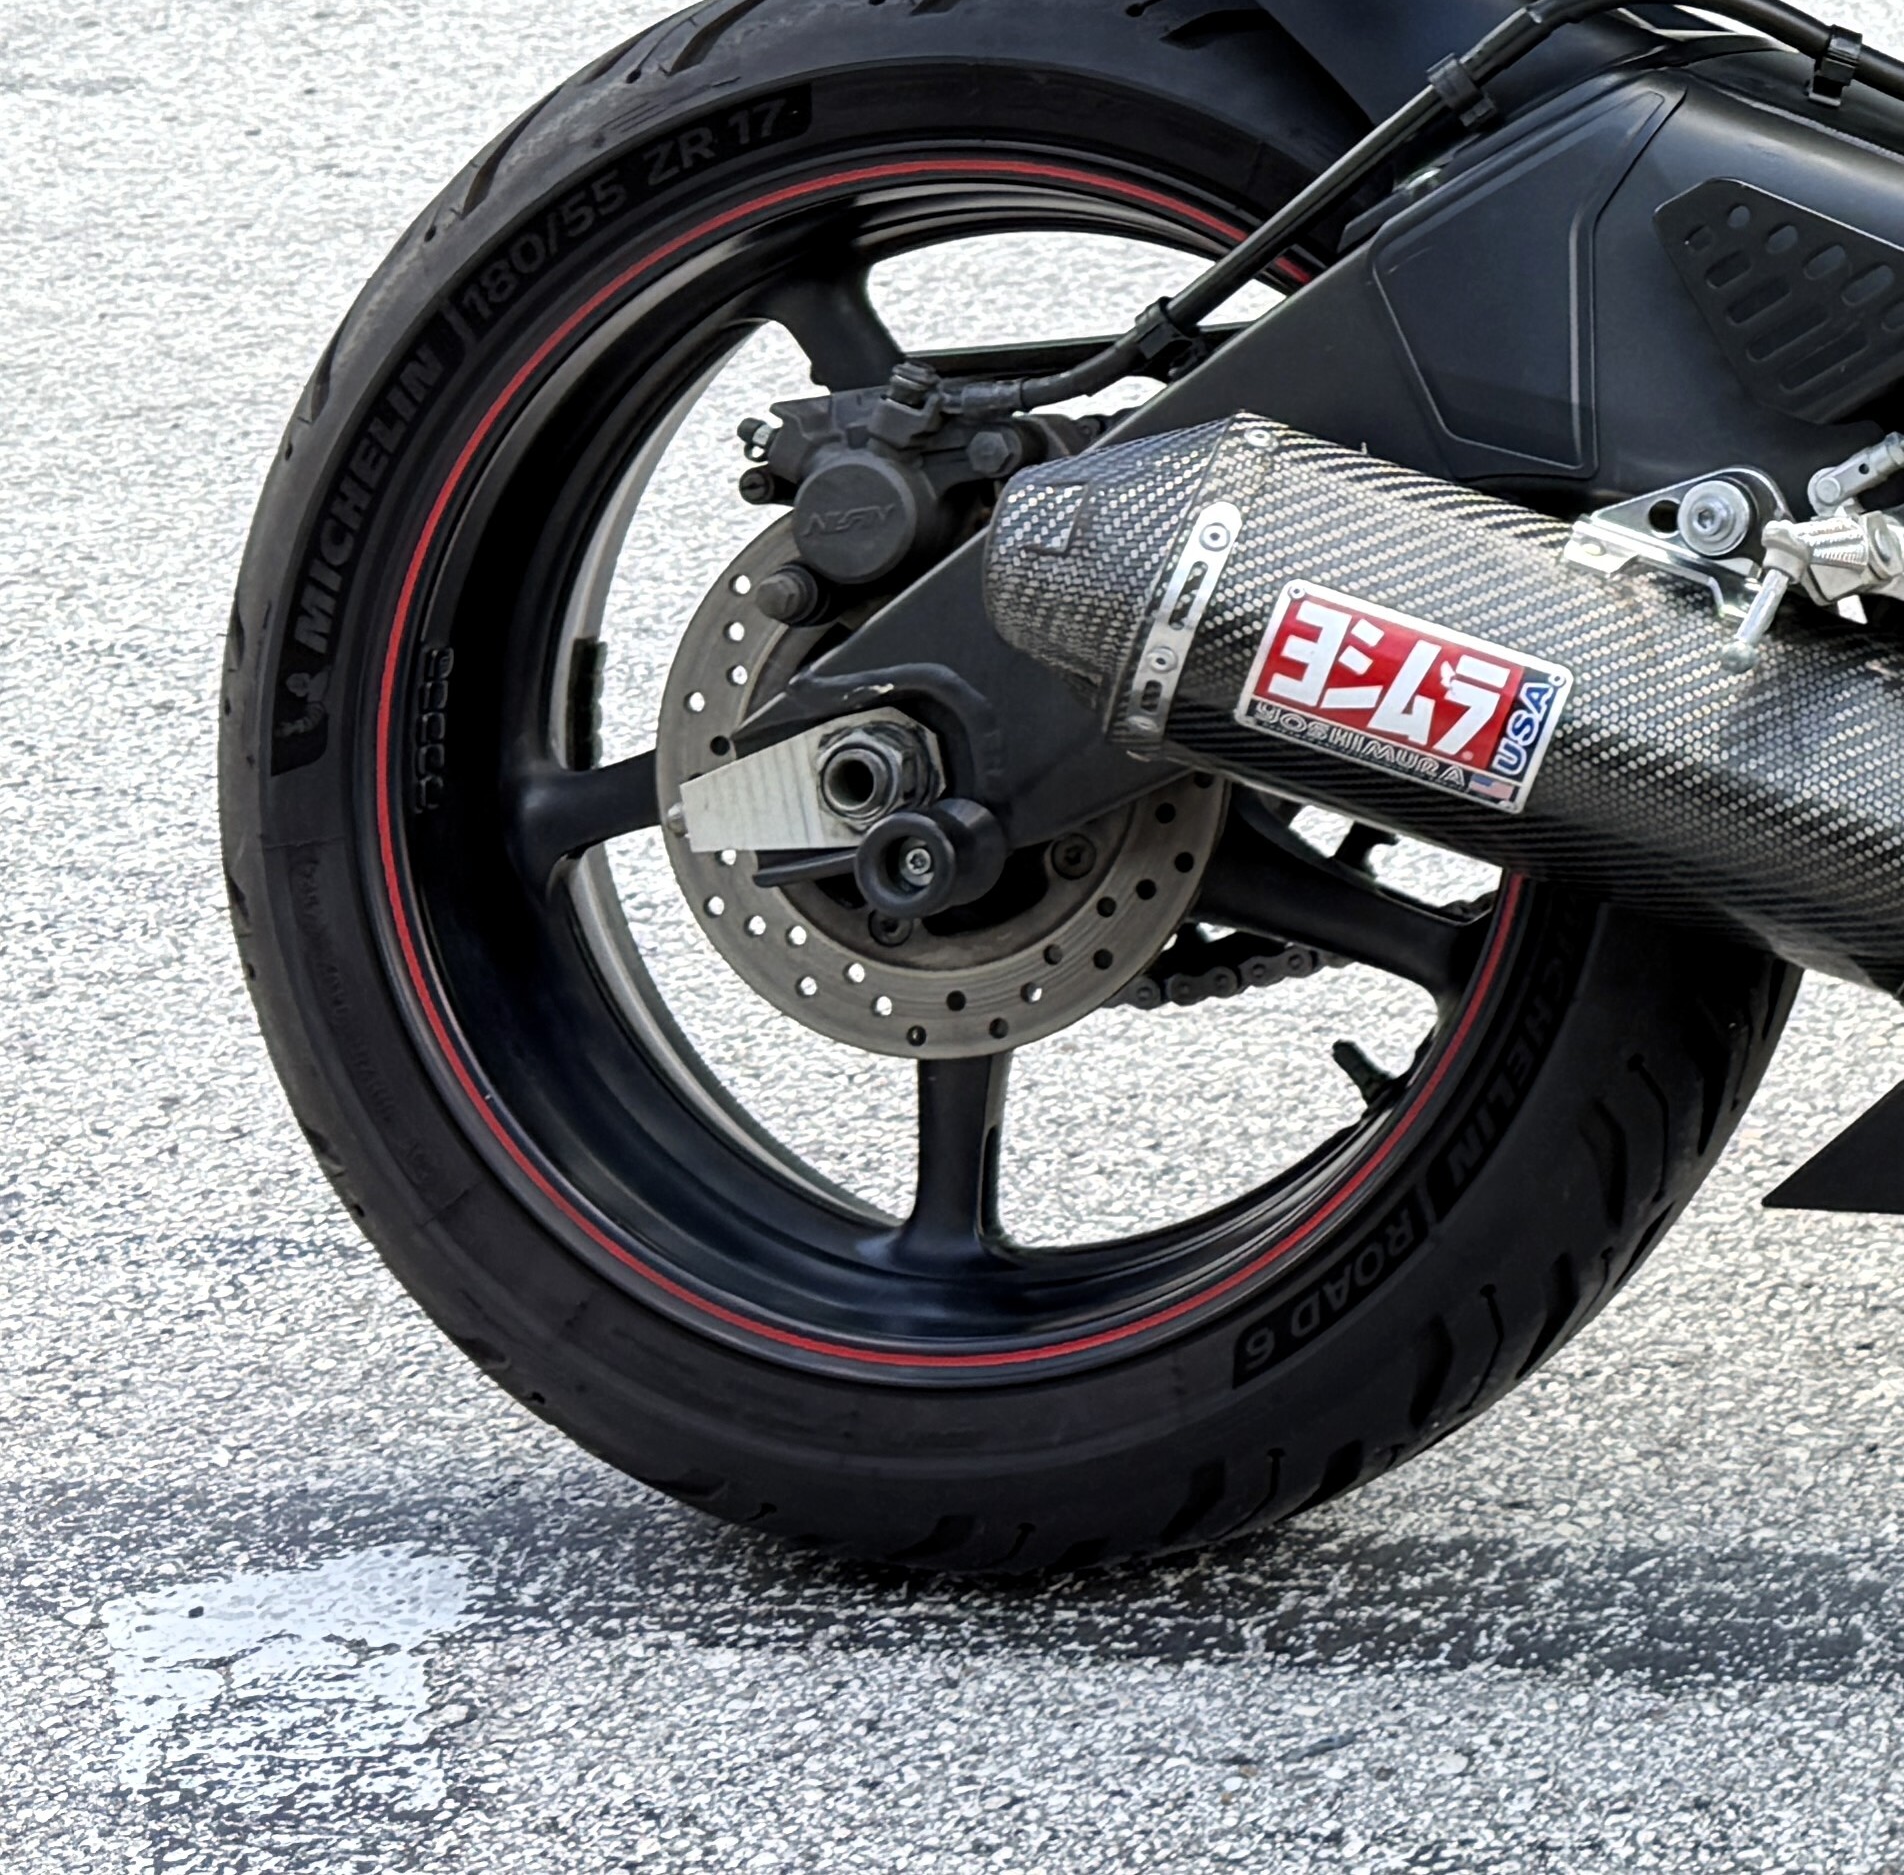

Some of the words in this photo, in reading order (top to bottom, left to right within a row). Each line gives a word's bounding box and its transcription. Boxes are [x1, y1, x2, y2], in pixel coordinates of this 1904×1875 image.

[295, 346, 450, 653] MICHELIN
[461, 169, 630, 318] 180/55
[641, 125, 716, 186] ZR
[728, 99, 787, 144] 17
[1267, 600, 1511, 757] ヨシムラ
[1493, 680, 1554, 778] USA
[1255, 701, 1467, 791] YOSHIMURA
[1291, 1192, 1418, 1340] ROAD
[1244, 1327, 1277, 1370] 6
